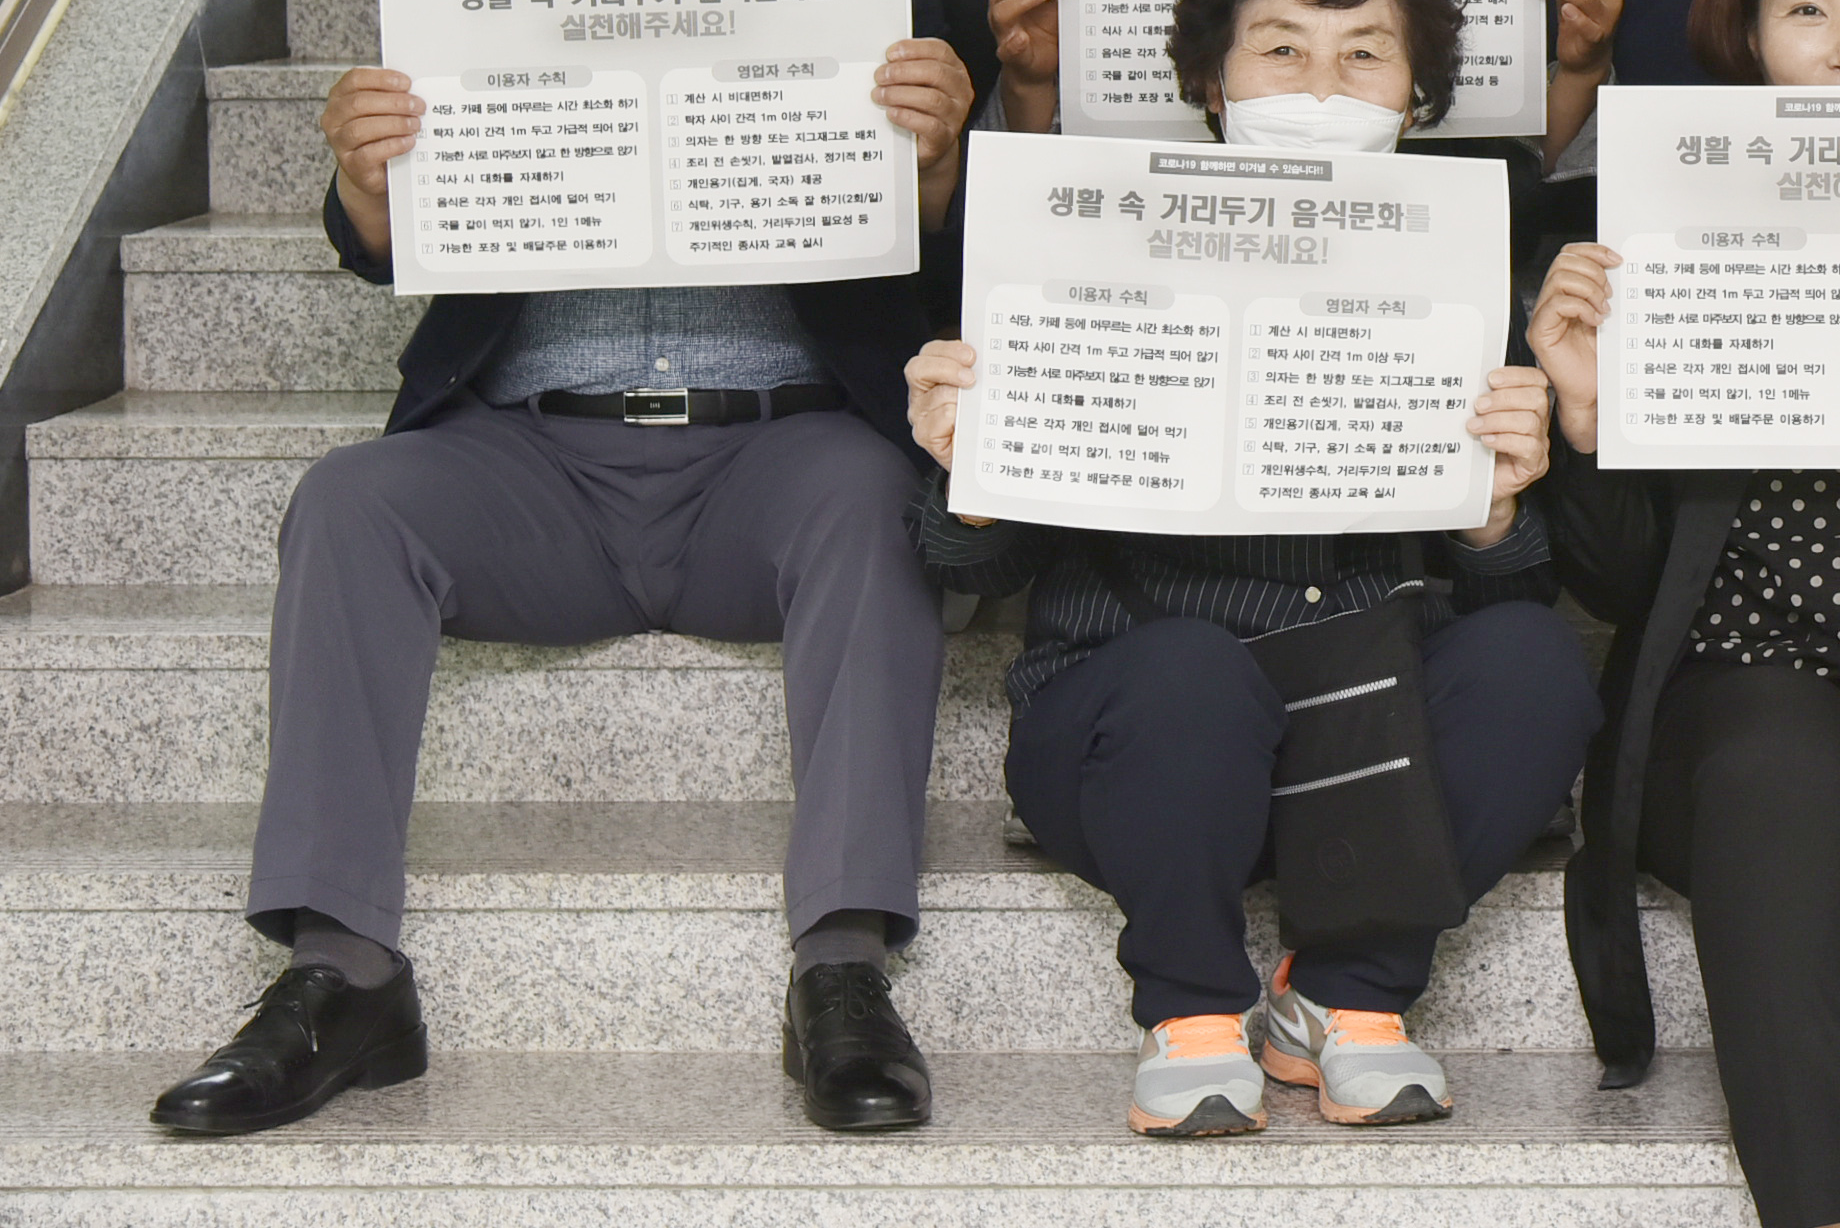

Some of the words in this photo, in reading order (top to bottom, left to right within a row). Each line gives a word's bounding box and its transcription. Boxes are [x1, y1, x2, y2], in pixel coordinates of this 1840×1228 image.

[560, 10, 735, 41] 실천해주세요!
[488, 73, 530, 87] 이용자
[538, 71, 565, 86] 수칙
[738, 64, 779, 79] 영업자
[787, 63, 814, 77] 수칙
[1784, 103, 1821, 112] 코로나19
[1676, 136, 1731, 165] 생활
[1746, 136, 1773, 165] 속
[1048, 187, 1104, 218] 생활
[1119, 191, 1145, 221] 속
[1160, 194, 1275, 227] 거리두기
[1290, 199, 1430, 232] 음식문화를
[1147, 229, 1328, 265] 실천해주세요!
[1702, 232, 1744, 247] 이용자
[1752, 233, 1780, 247] 수칙
[1069, 287, 1112, 303] 이용자
[1119, 290, 1147, 305] 수칙
[1326, 299, 1369, 314] 영업자
[1377, 301, 1405, 315] 수칙
[1259, 487, 1303, 498] 주기적인
[1309, 488, 1341, 499] 종사자
[1347, 488, 1368, 498] 교육
[1375, 488, 1395, 498] 실시
